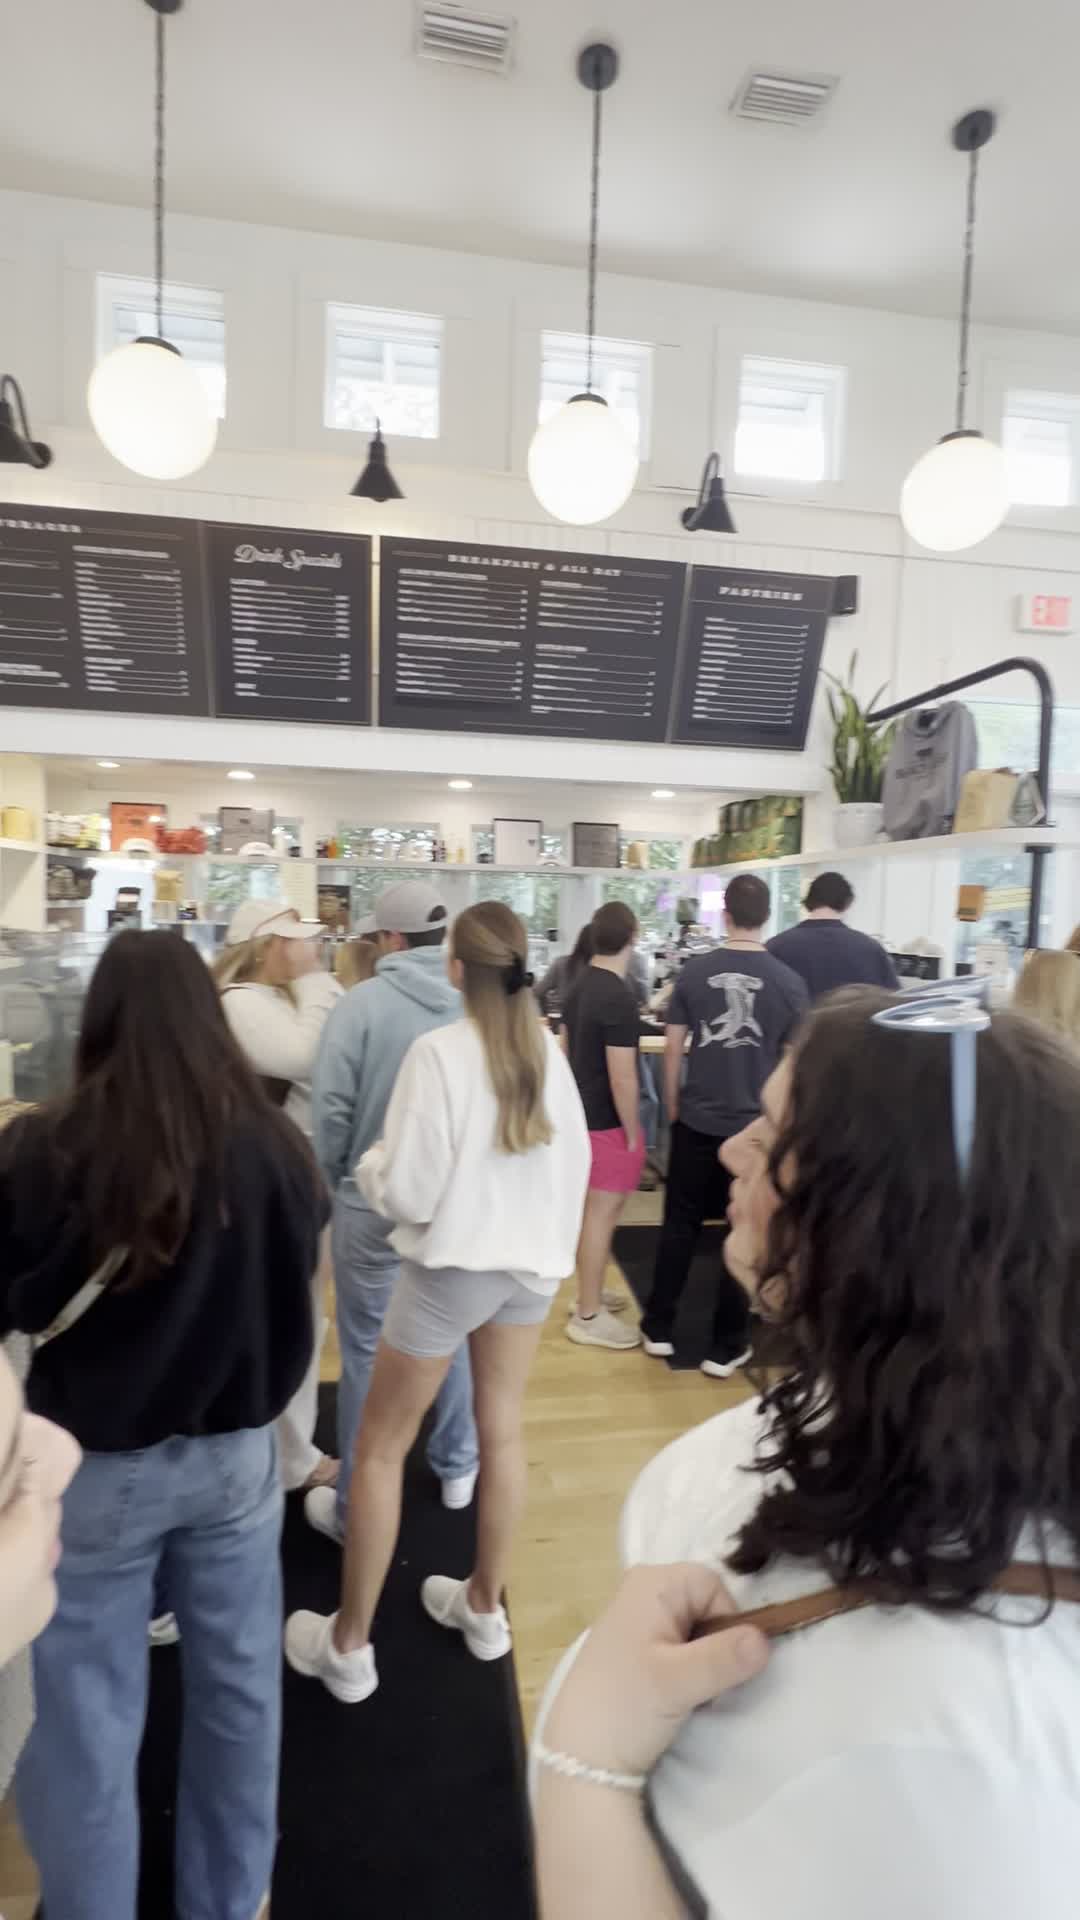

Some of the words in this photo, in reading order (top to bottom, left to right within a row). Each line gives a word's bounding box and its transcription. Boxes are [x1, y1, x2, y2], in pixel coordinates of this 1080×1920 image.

[233, 544, 284, 564] Drink
[281, 549, 343, 572] Specials
[447, 554, 540, 569] BREAKFAST
[560, 565, 589, 574] ALL
[592, 567, 622, 577] DAY
[718, 586, 805, 601] PASTRIES
[1032, 595, 1071, 627] EXIT
